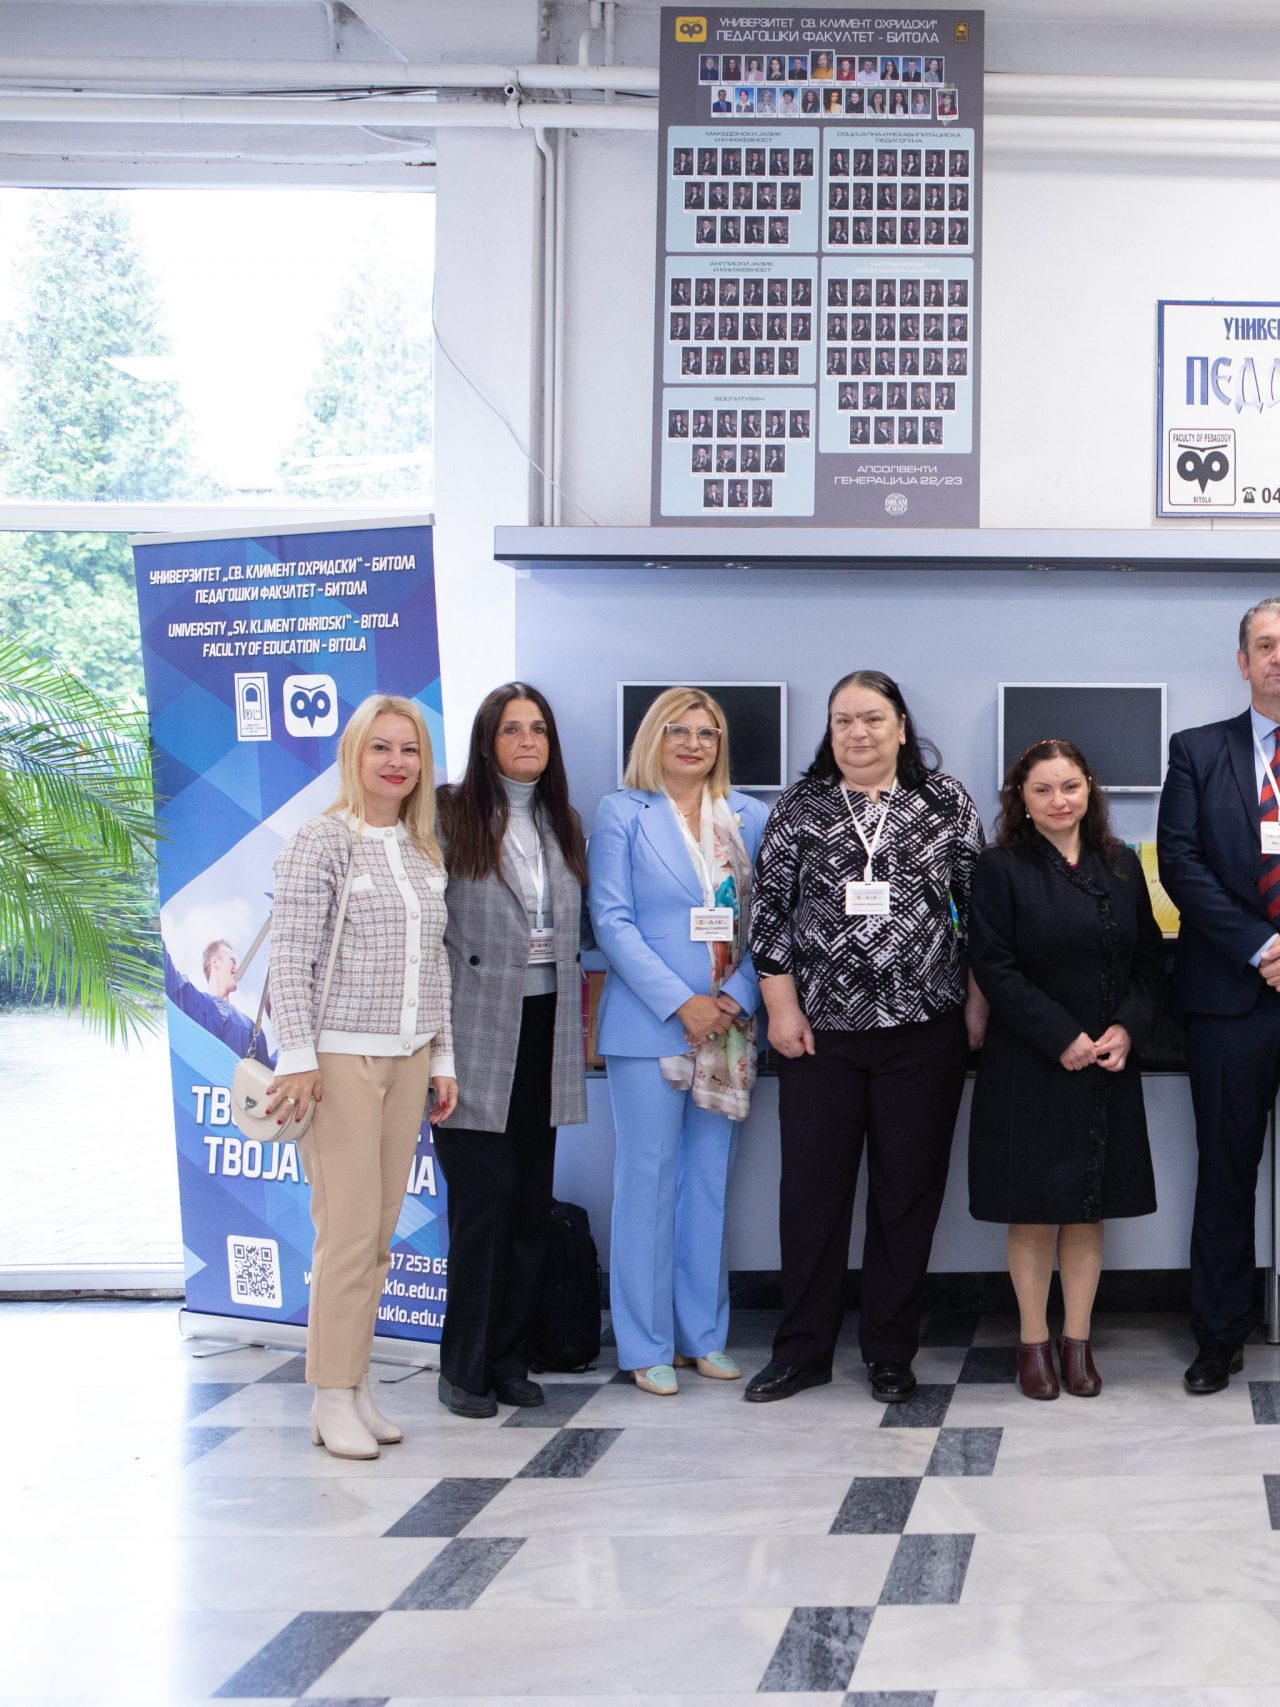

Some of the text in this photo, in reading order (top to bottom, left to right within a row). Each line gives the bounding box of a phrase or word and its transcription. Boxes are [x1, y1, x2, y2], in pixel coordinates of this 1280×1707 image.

[719, 17, 794, 28] УНИВЕРЗИТЕТ
[819, 18, 872, 29] КЛИМЕНТ
[716, 30, 799, 42] ПЕДАГОШКИ
[802, 31, 875, 43] ФАКУЛТЕТ
[886, 32, 940, 43] БИТОЛА
[857, 465, 938, 473] АПСОЛВЕНТИ
[834, 476, 963, 486] ГЕНЕРАЦИЈА 22/23
[150, 567, 221, 585] УНИВЕРЗИТЕТ
[246, 562, 296, 580] КЛИМЕНТ
[371, 555, 416, 572] БИТОЛА
[195, 586, 258, 605] ПЕДАГОШКИ
[260, 583, 315, 600] ФАКУЛТЕТ
[324, 580, 368, 597] БИТОЛА
[168, 621, 226, 638] UNIVERSITY
[250, 618, 296, 634] KLIMENT
[361, 613, 399, 629] BITOLA
[203, 641, 247, 658] FACULTY
[248, 641, 262, 656] OF
[263, 638, 320, 655] EDUCATION
[328, 637, 367, 653] BITOLA
[405, 1254, 431, 1273] 253
